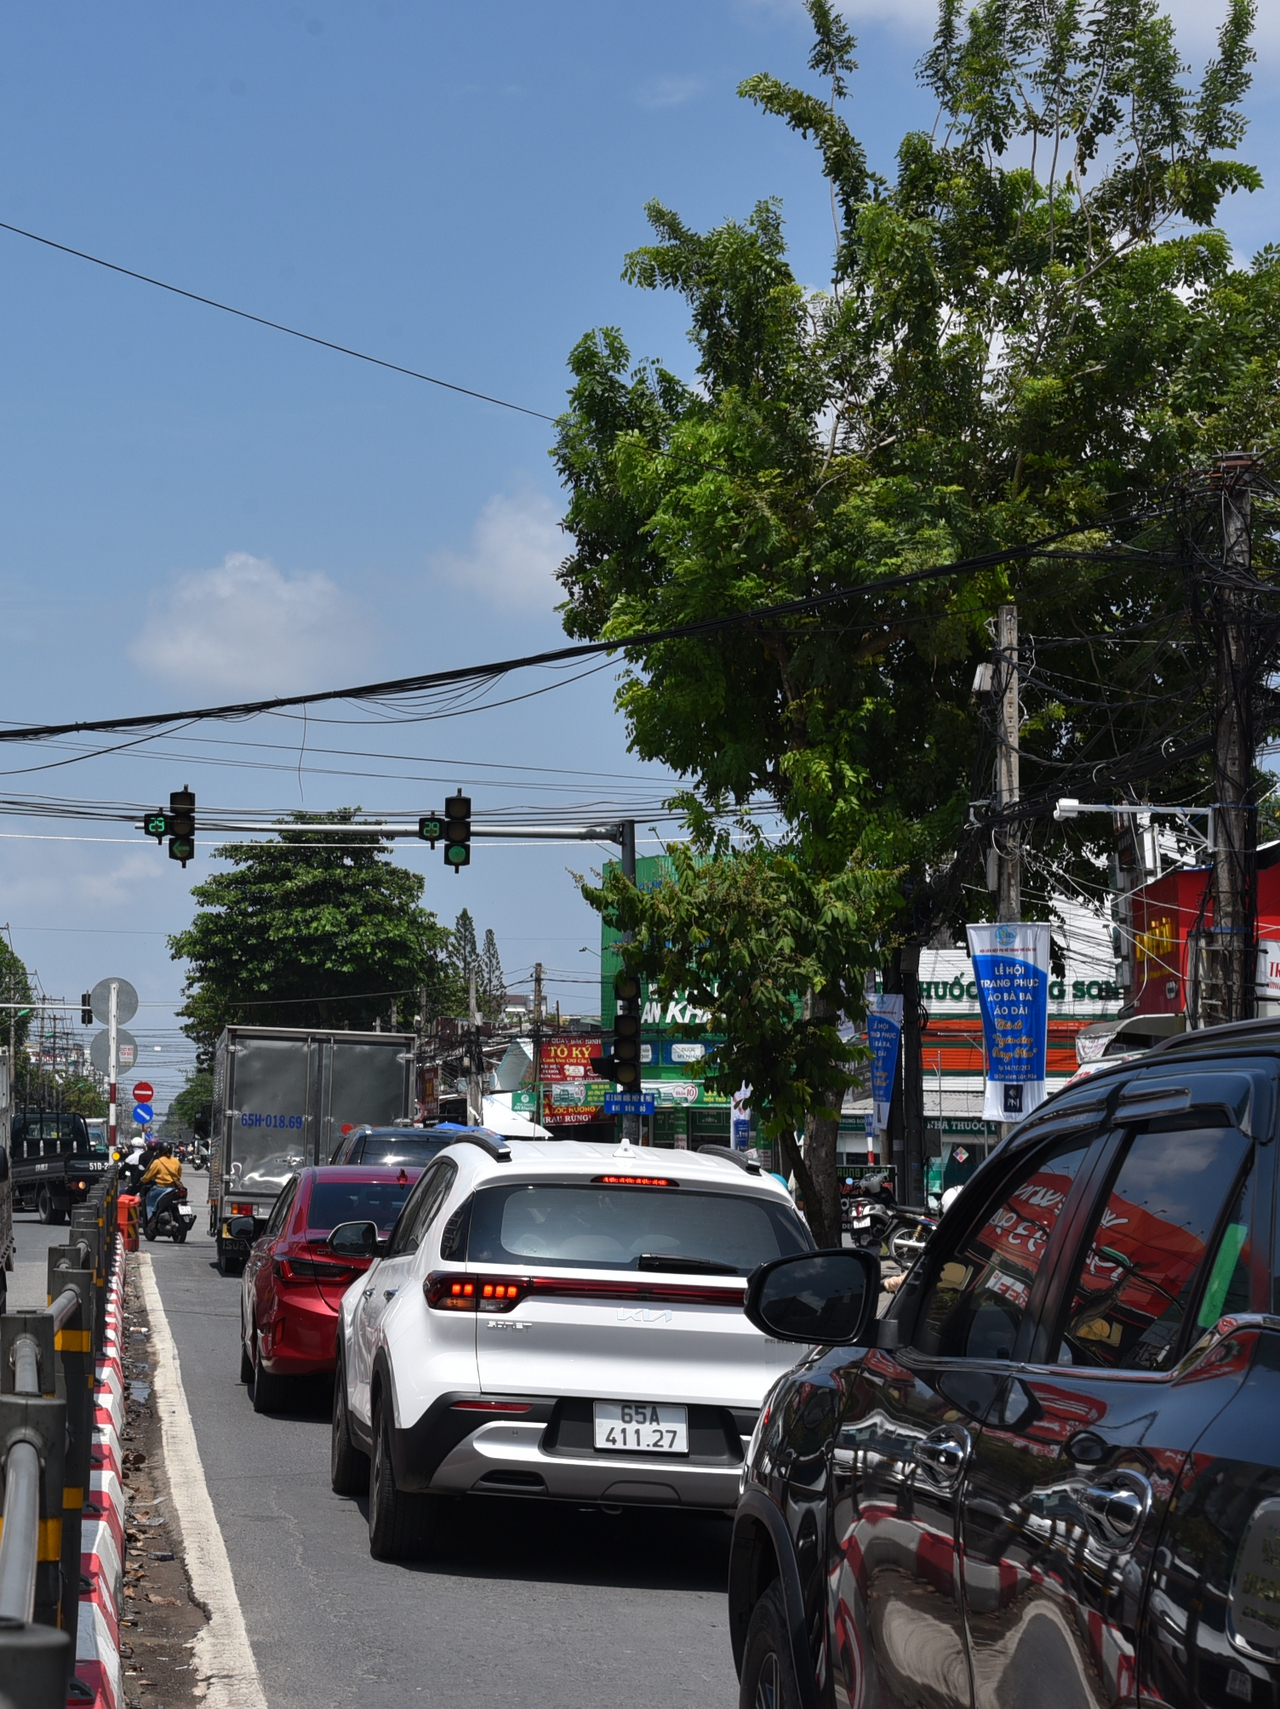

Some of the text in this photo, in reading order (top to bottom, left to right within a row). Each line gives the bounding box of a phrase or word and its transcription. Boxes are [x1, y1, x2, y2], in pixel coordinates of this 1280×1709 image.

[423, 821, 440, 837] 29
[994, 963, 1025, 977] LỄ HỘI
[919, 972, 980, 1000] HUỐC
[980, 978, 1039, 989] TRANG PHỤC
[1011, 1006, 1028, 1015] DÀI
[837, 1168, 861, 1177] RUNG
[617, 1307, 673, 1323] KIA
[620, 1403, 661, 1426] 65A
[605, 1428, 678, 1449] 411.27
